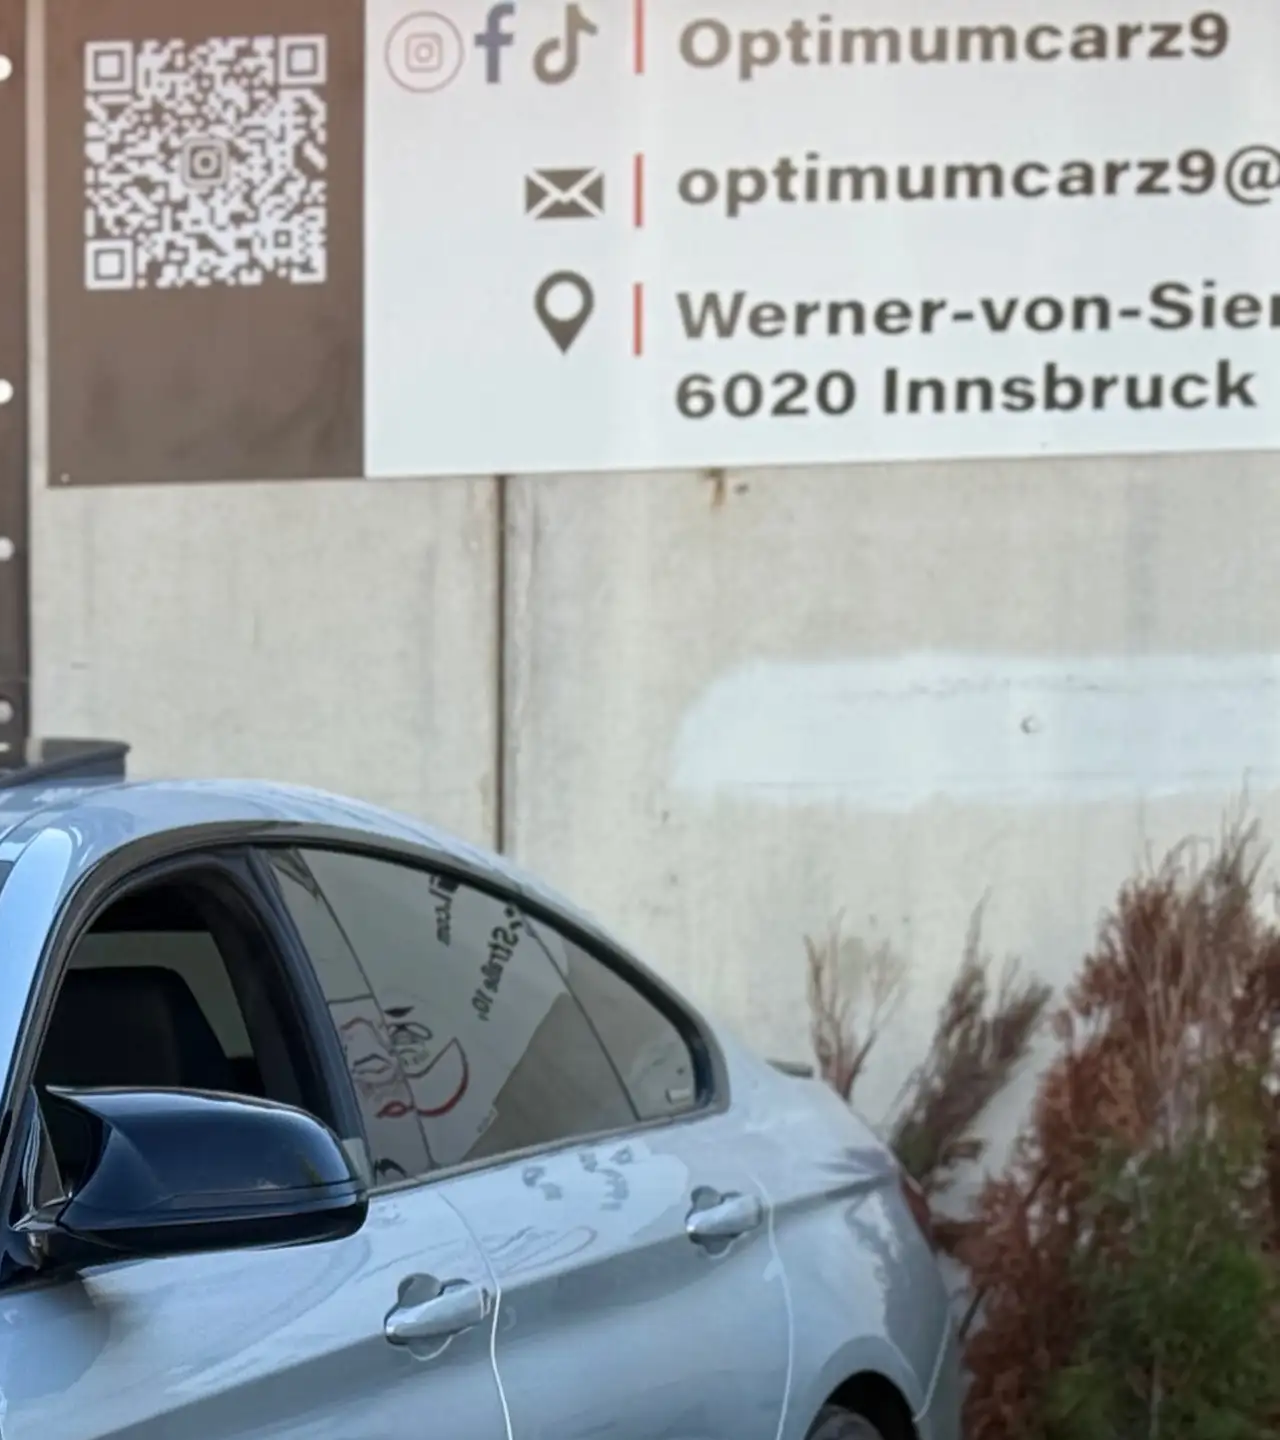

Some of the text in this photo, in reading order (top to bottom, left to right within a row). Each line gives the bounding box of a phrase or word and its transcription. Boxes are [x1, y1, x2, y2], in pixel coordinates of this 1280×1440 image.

[678, 11, 1230, 82] Optimumcarz9
[677, 143, 1280, 219] optimumcarz9@
[675, 279, 1280, 340] Werner-von-Sie
[675, 358, 1258, 420] 6020 Innsbruck
